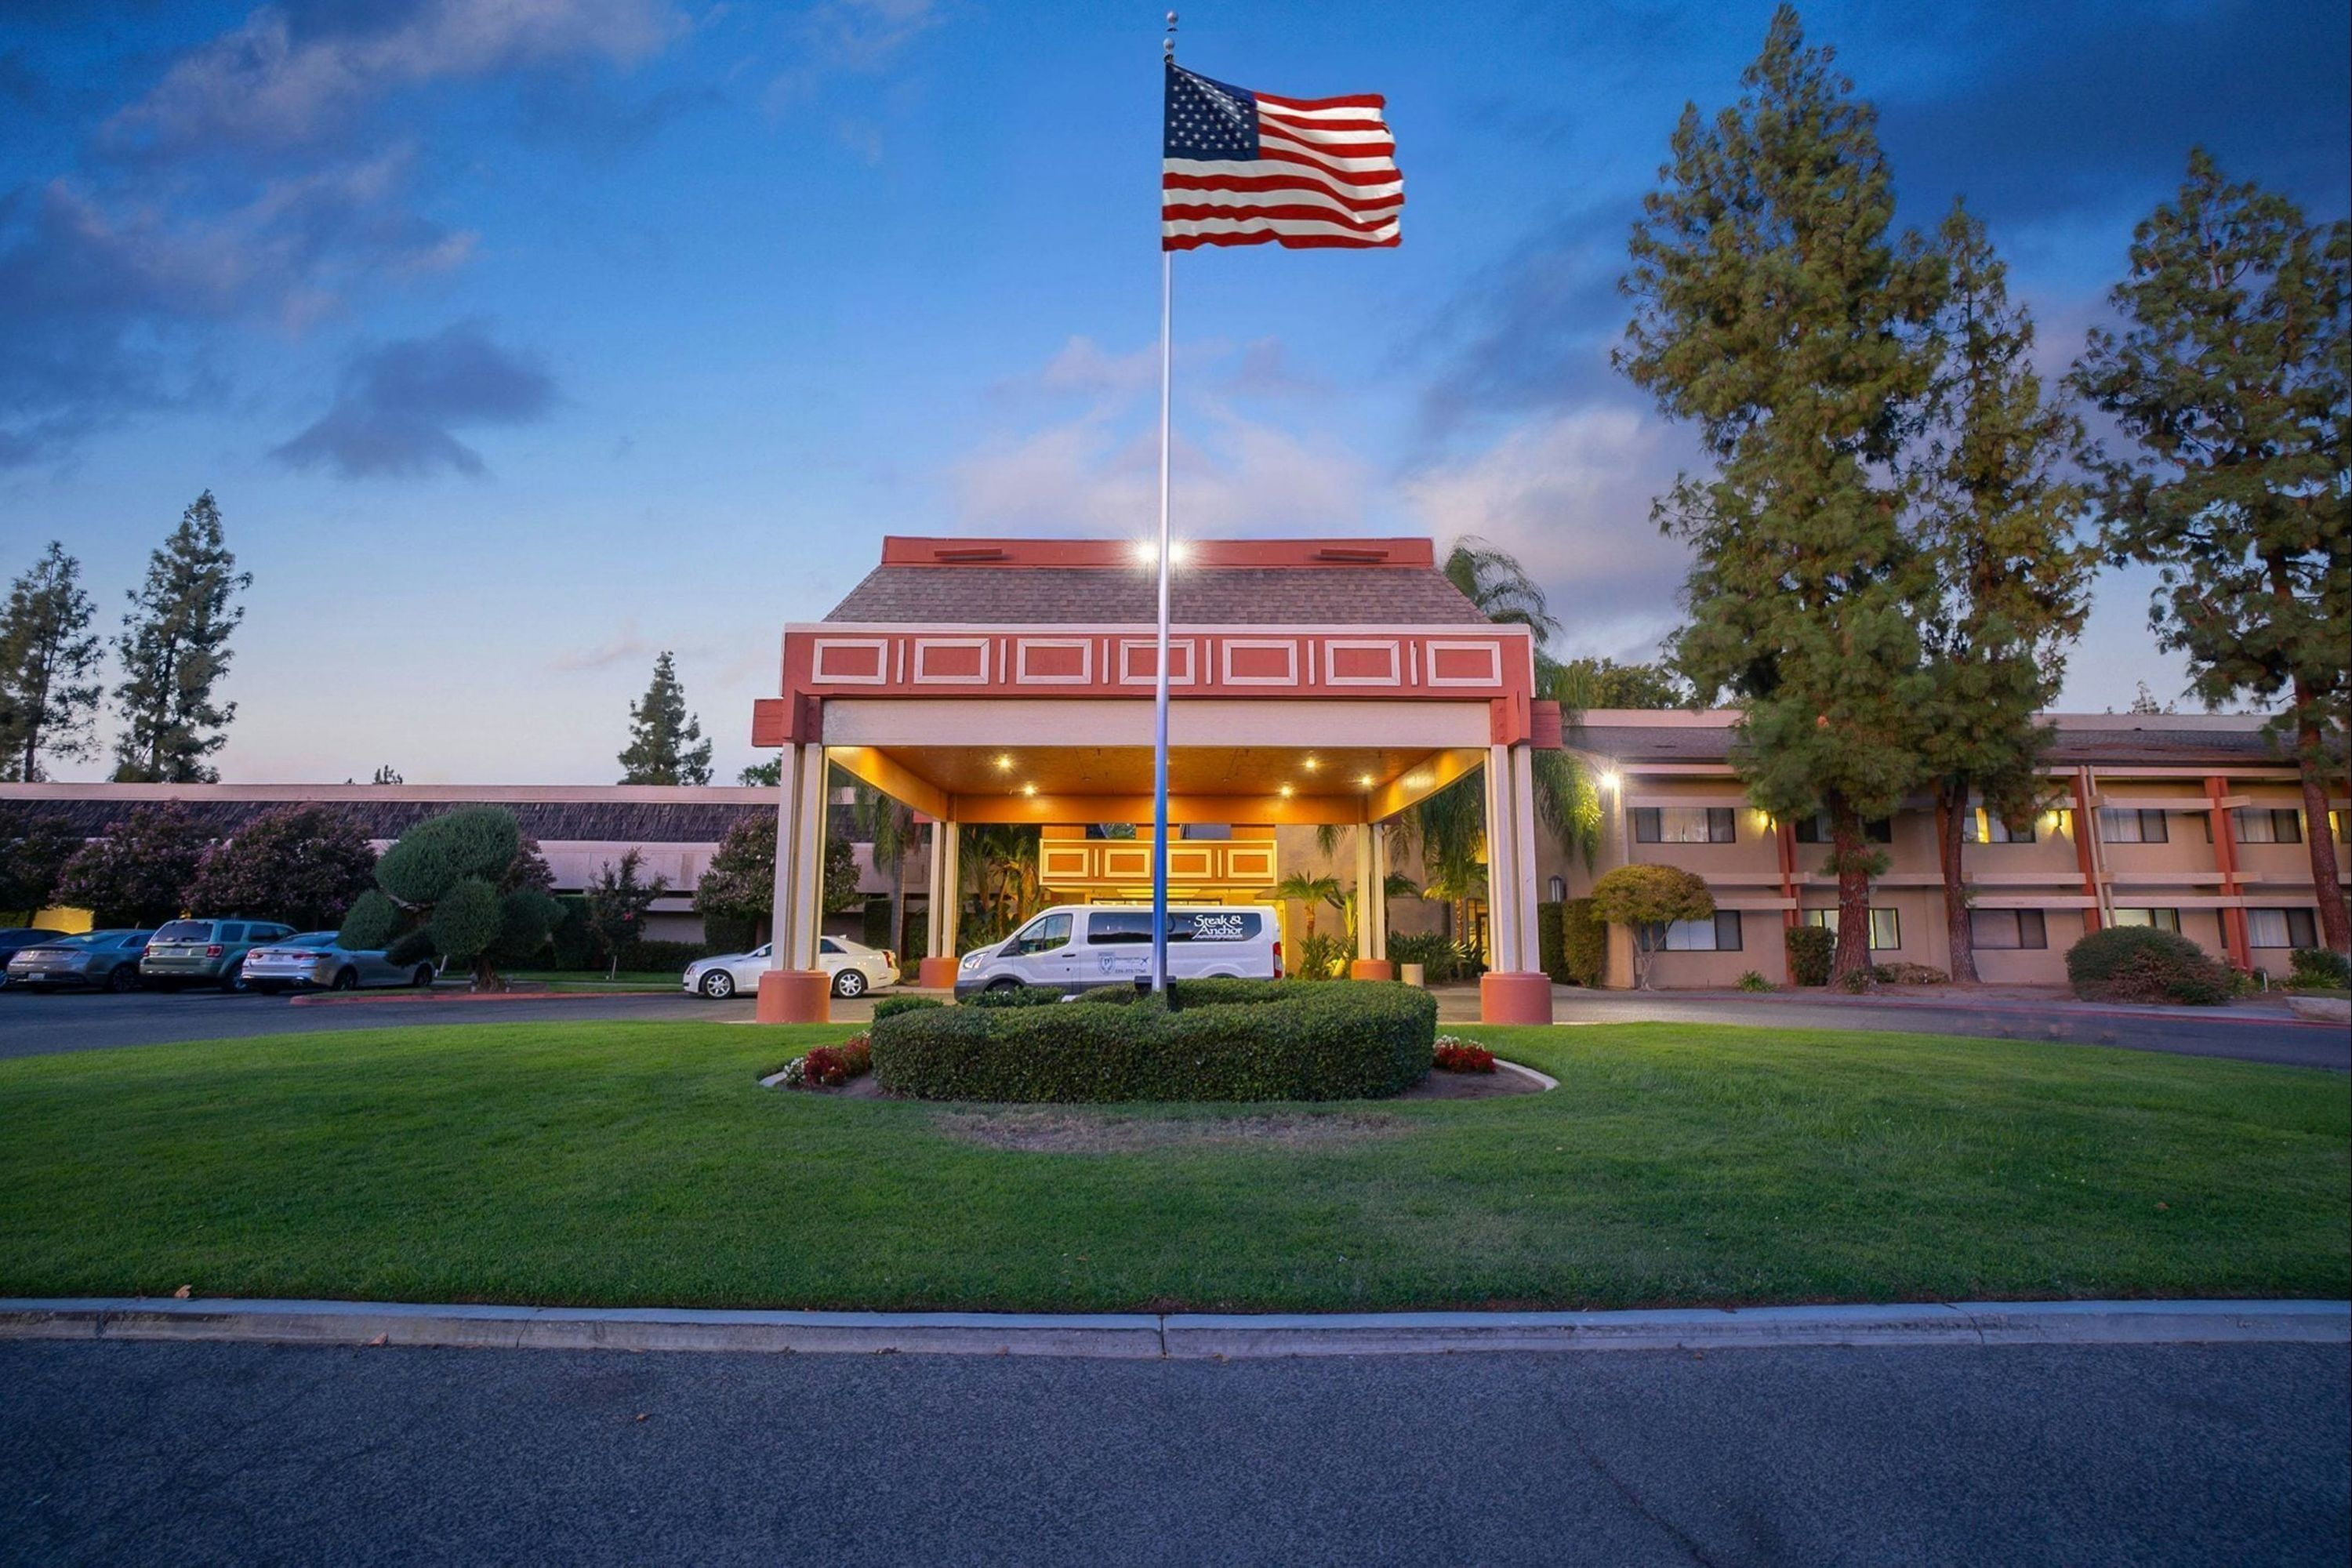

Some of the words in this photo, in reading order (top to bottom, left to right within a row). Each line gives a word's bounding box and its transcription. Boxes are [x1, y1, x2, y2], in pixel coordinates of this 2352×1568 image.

[1194, 914, 1233, 927] Steak
[1229, 915, 1243, 924] &
[1192, 925, 1243, 939] Anchor
